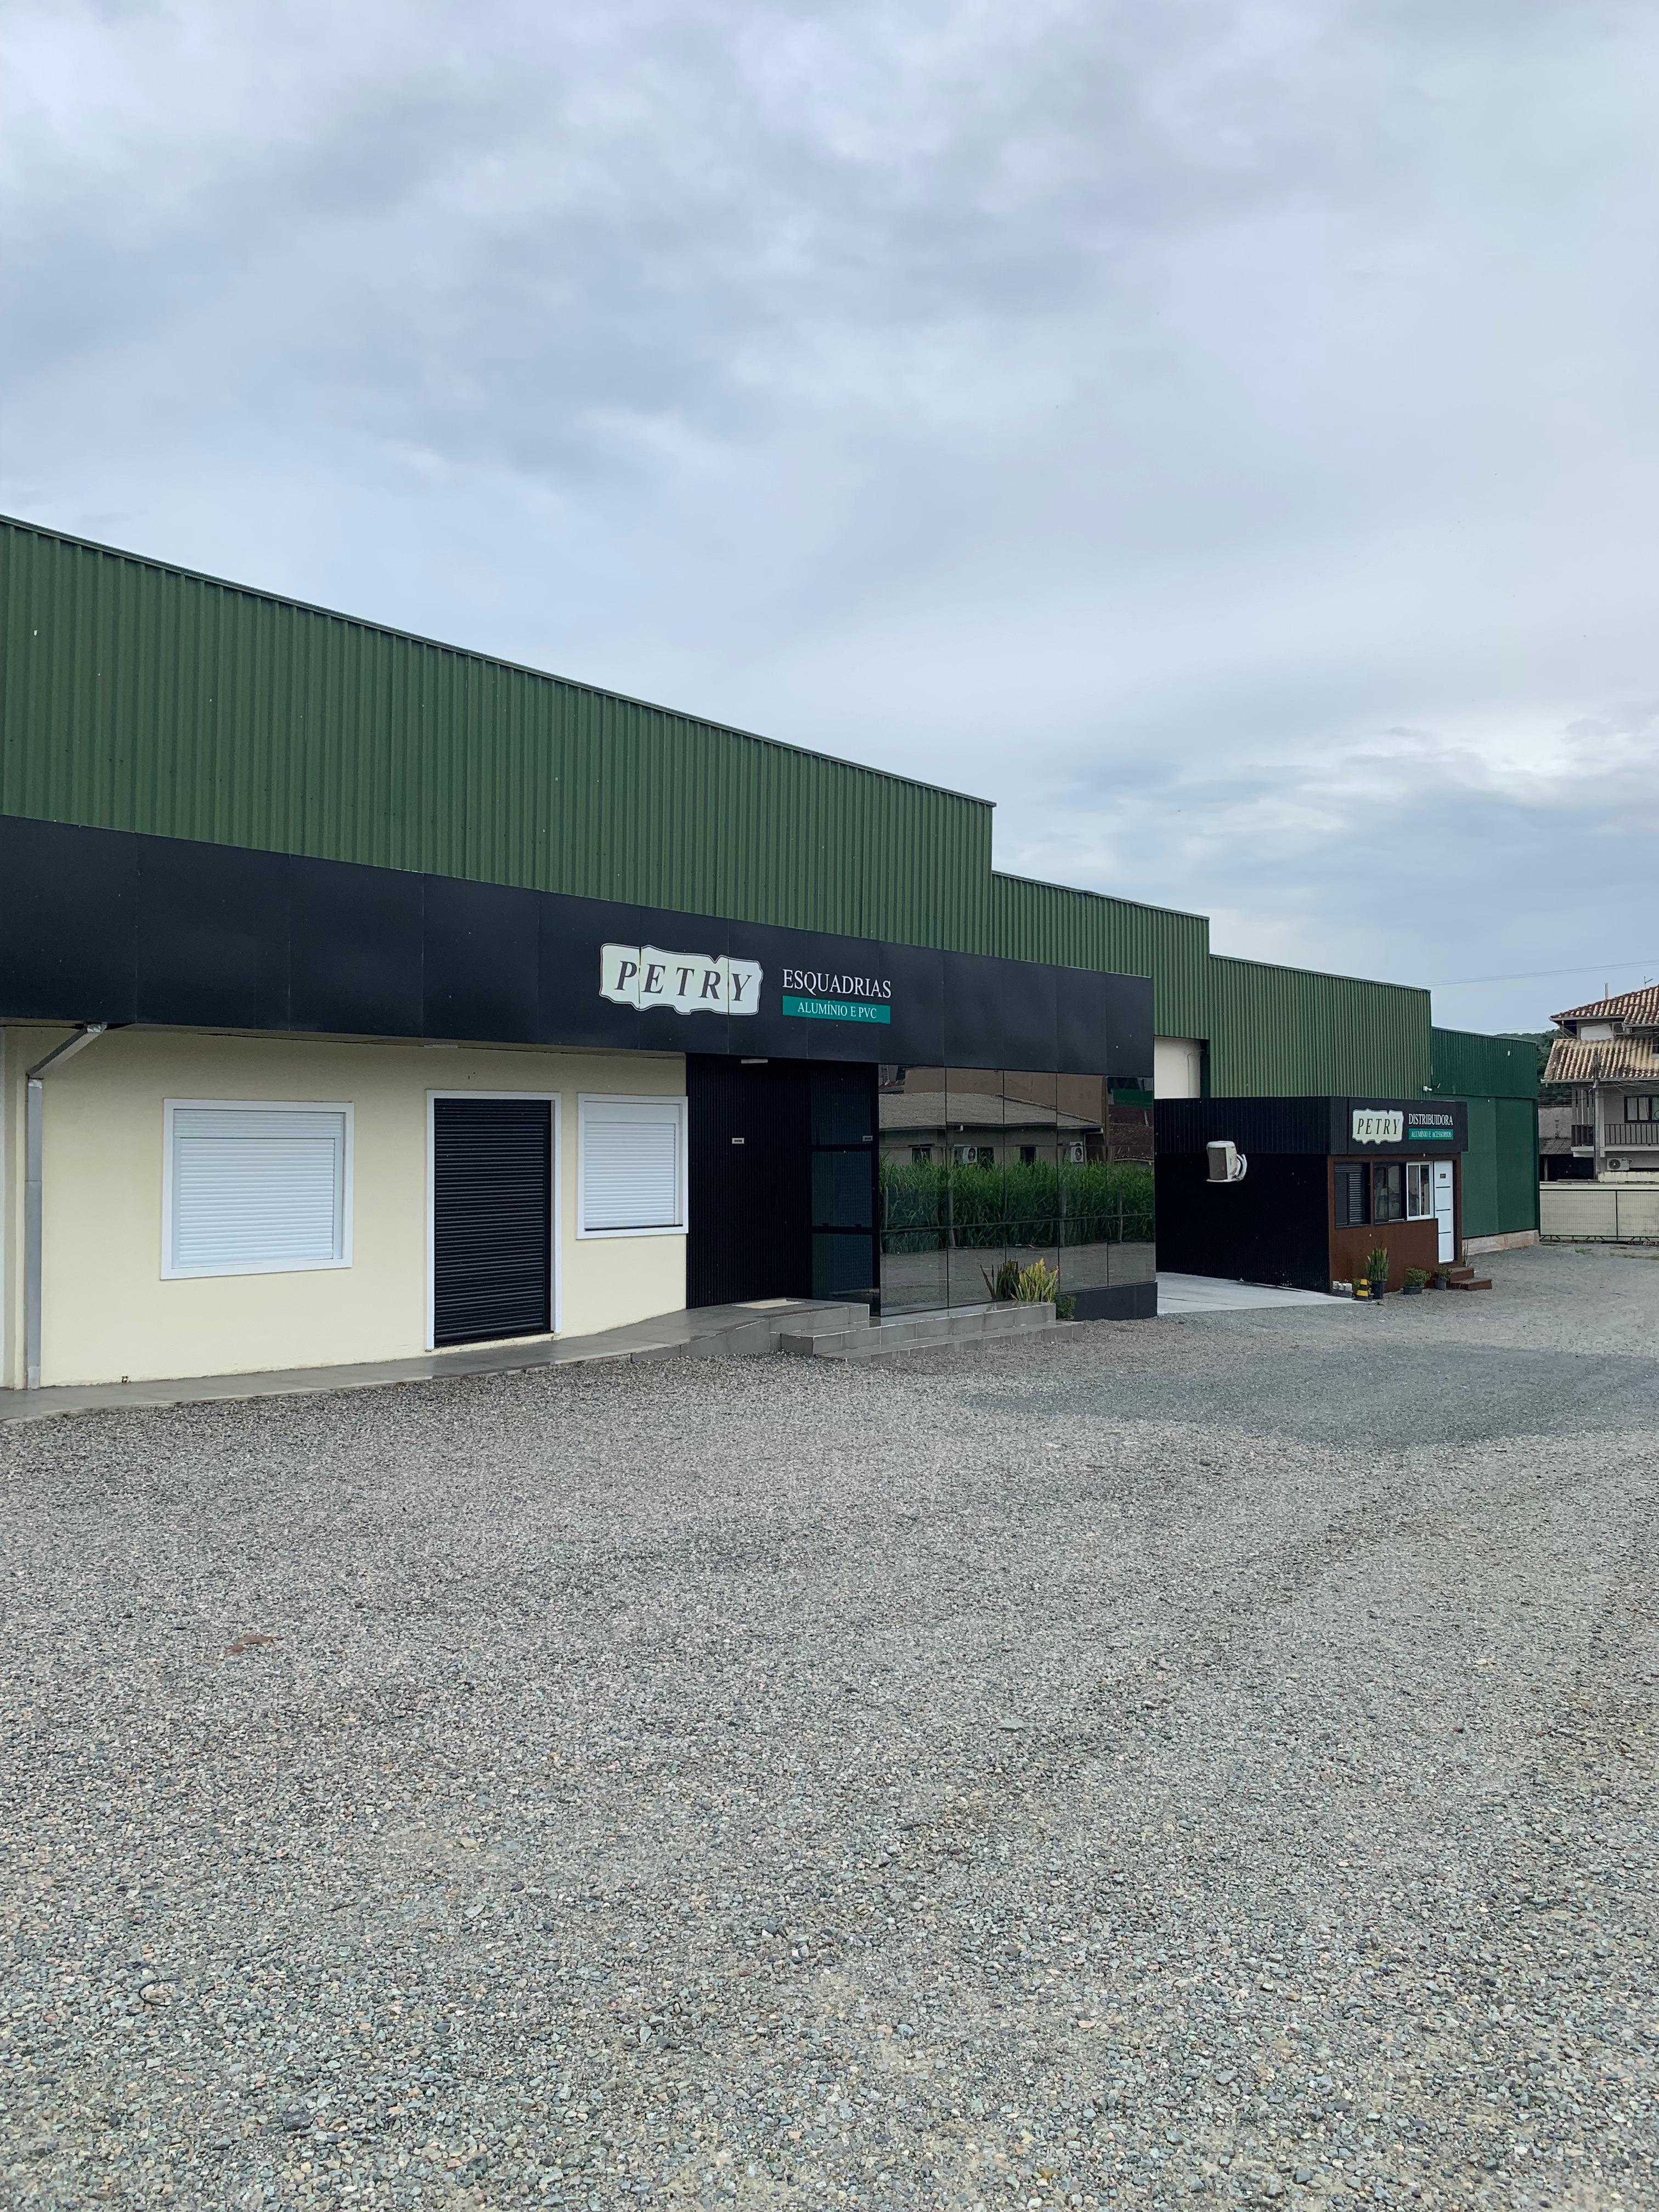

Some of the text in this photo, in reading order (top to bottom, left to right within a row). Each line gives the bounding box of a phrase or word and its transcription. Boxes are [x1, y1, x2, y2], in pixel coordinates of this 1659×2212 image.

[614, 960, 753, 1002] PETRY
[782, 969, 891, 998] ESQUADRIAS
[798, 1001, 877, 1019] ALUMÍNIO E PVC
[1357, 1118, 1400, 1135] PETRY
[1408, 1113, 1453, 1126] DISTRIBUIDORA
